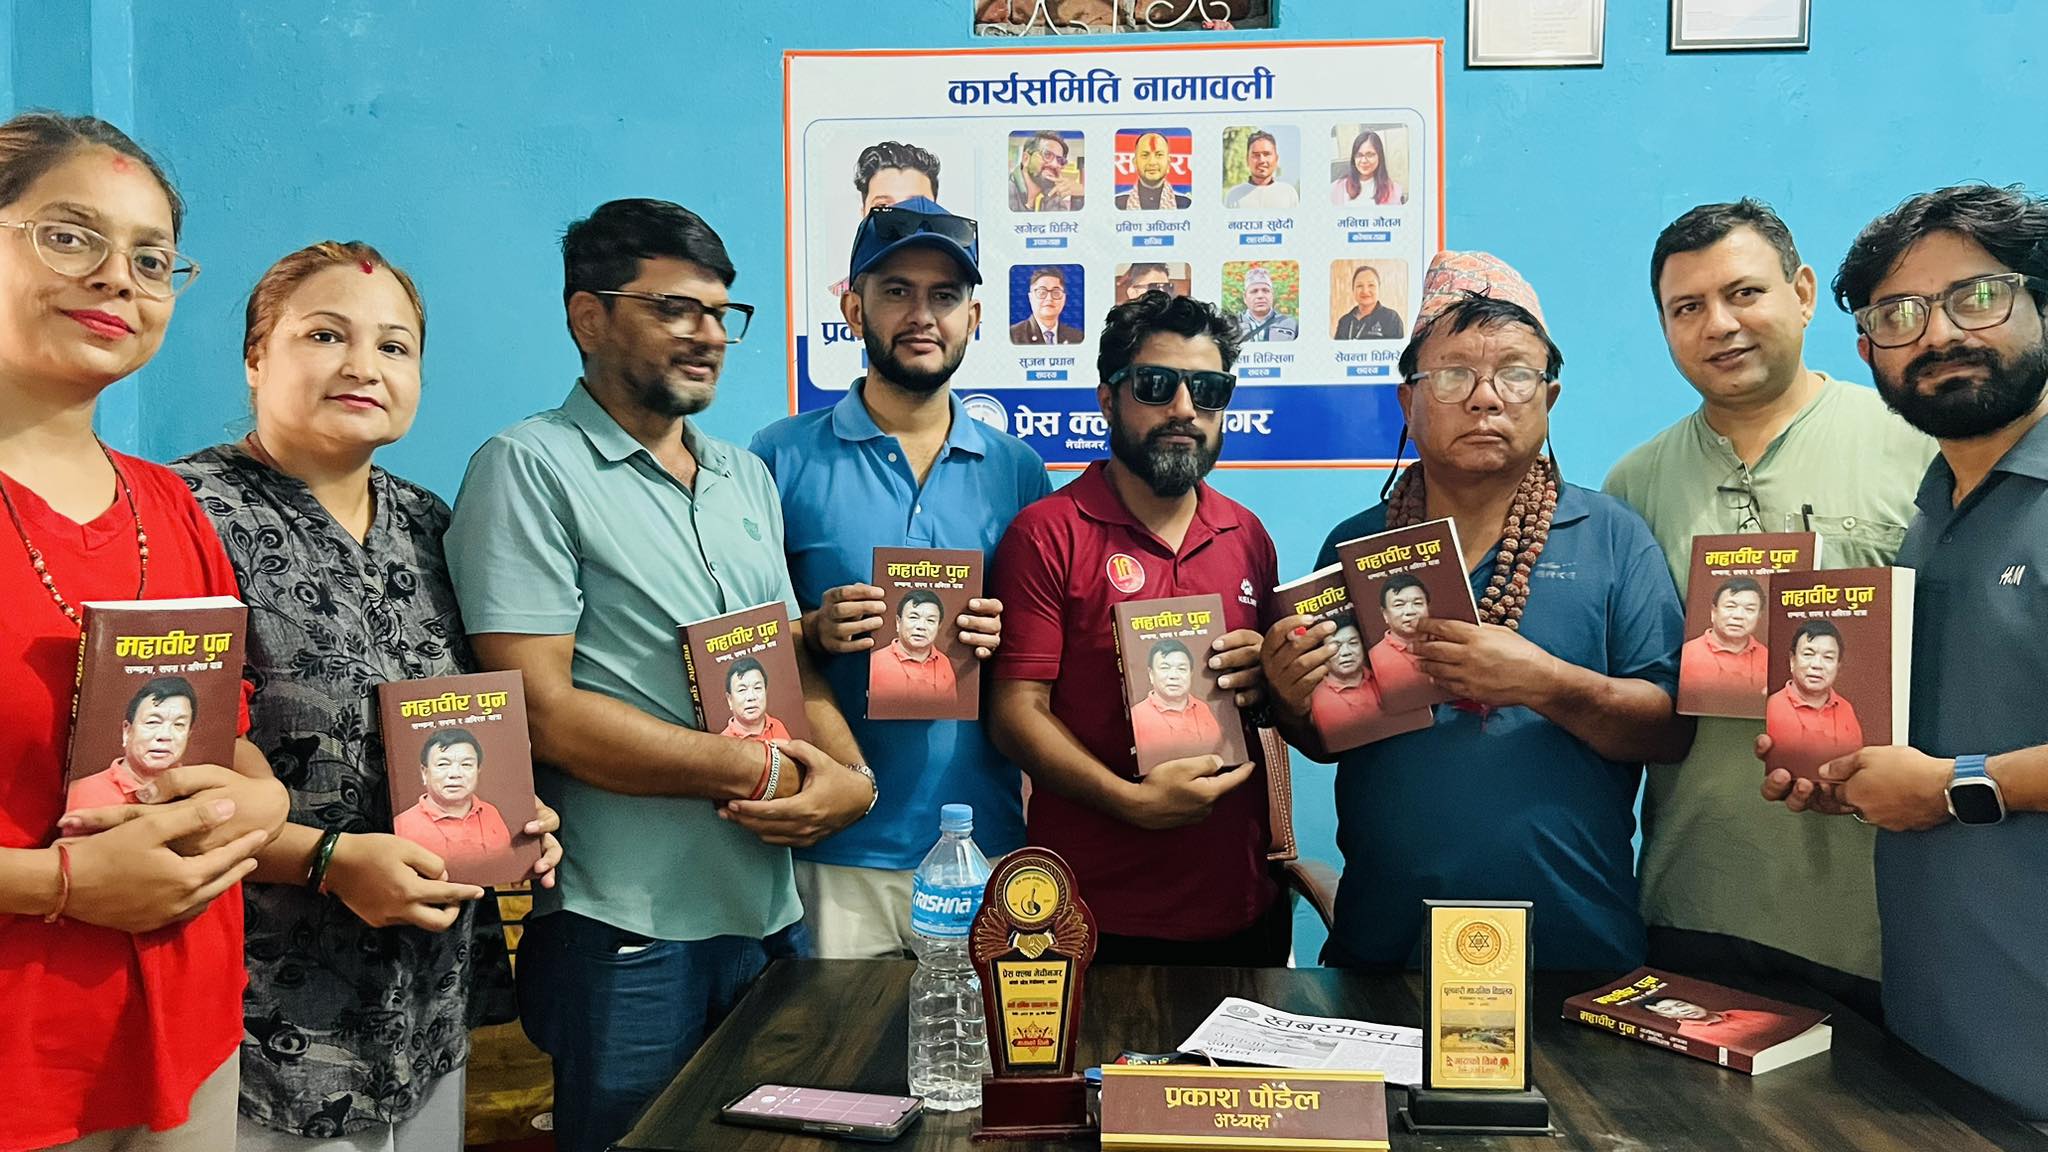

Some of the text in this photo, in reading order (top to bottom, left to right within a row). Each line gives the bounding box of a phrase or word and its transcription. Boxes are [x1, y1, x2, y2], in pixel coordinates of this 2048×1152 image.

[948, 66, 1275, 106] कार्यसमिति नामावली
[1050, 221, 1079, 233] घिमिरे
[1145, 220, 1191, 232] अधिकारी
[1228, 219, 1263, 231] नवराज
[1372, 216, 1401, 228] गौतम
[1014, 405, 1061, 438] प्रेस
[1355, 539, 1441, 572] महावीर पुन
[1705, 547, 1799, 569] महावीर पुन
[887, 561, 970, 583] महावीर पुन
[1294, 586, 1346, 615] महावीर
[1781, 584, 1876, 610] महावीर पुन
[1131, 610, 1212, 631] महावीर पुन
[116, 630, 233, 661] महावीर पुन
[705, 620, 778, 653] महावीर पुन
[400, 691, 508, 718] महावीर पुन
[1580, 1010, 1636, 1036] महावीर पुन
[1164, 1087, 1240, 1109] प्रकाश
[1214, 1112, 1271, 1131] अध्यक्ष
